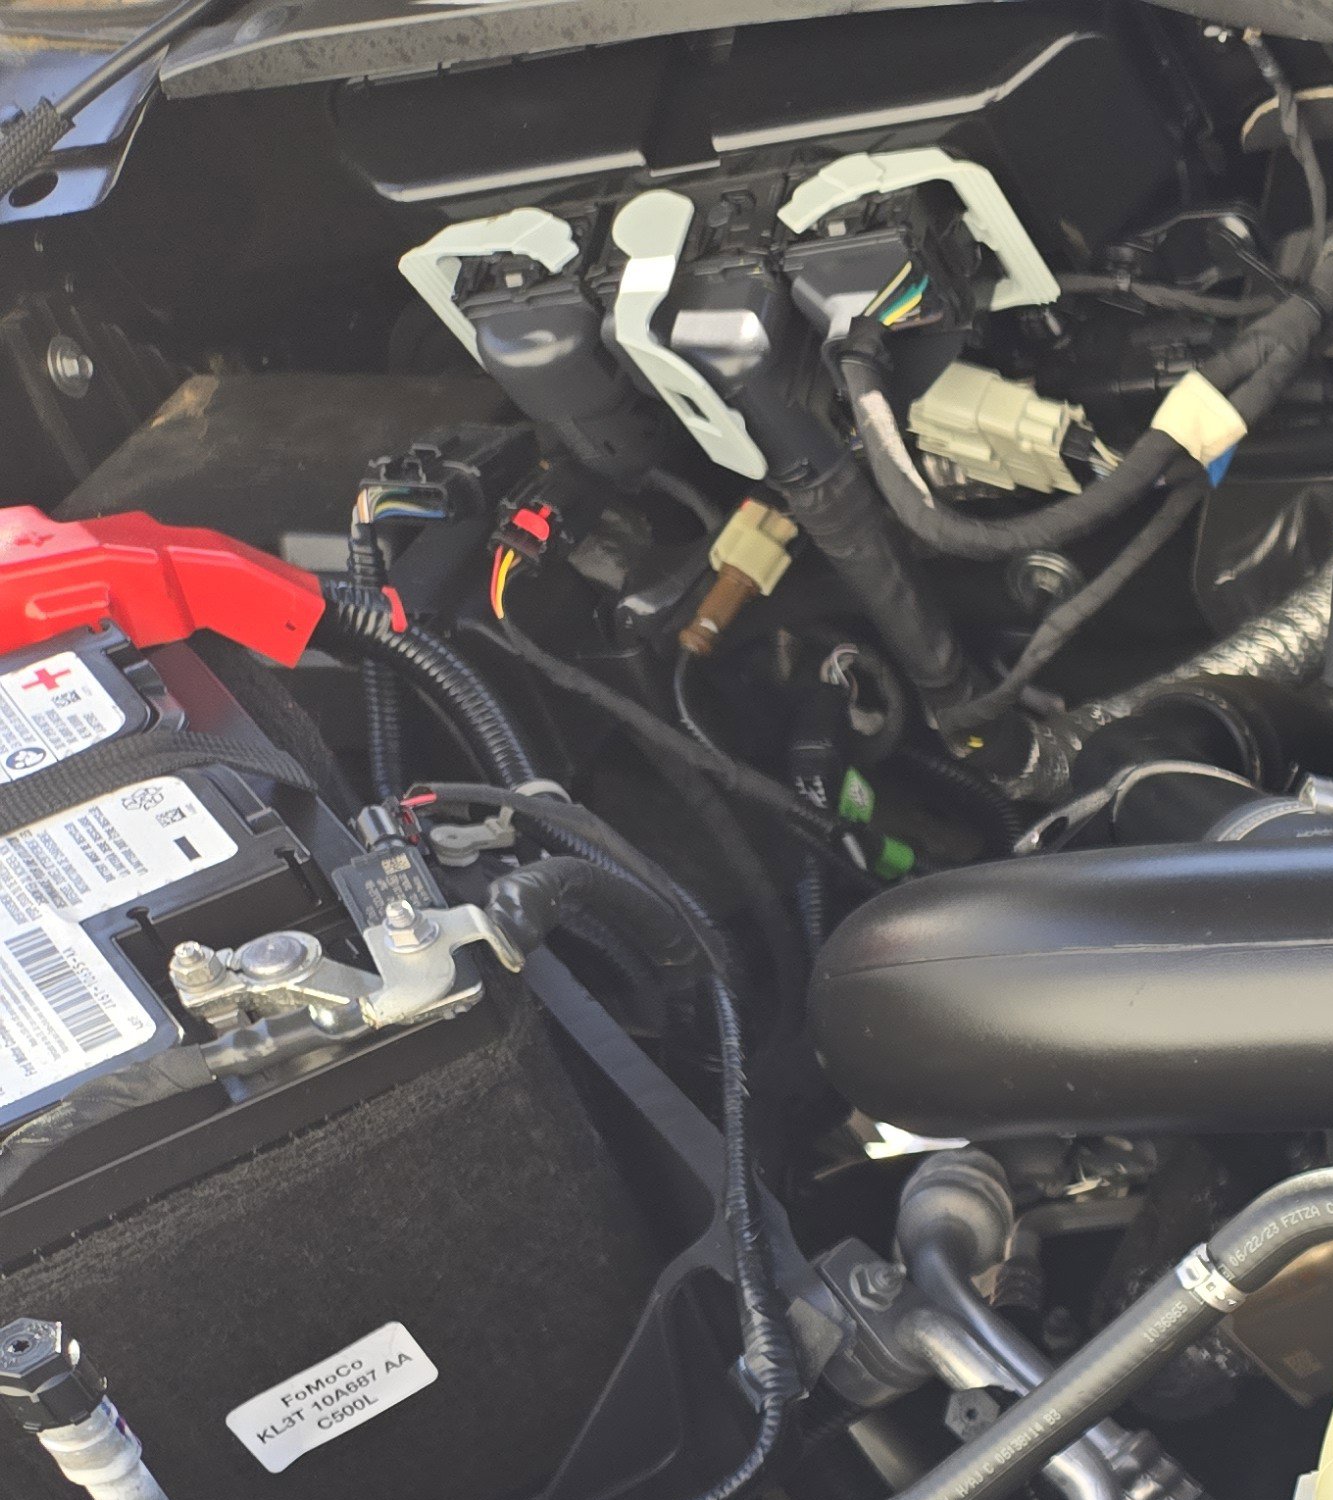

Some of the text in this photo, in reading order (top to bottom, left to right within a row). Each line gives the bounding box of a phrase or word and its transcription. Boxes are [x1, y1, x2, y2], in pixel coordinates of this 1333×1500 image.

[1229, 1222, 1280, 1267] 06/22/23
[256, 1352, 413, 1444] KL3T 10A687 AA
[281, 1358, 364, 1408] FoMoCo
[317, 1393, 379, 1430] C500L
